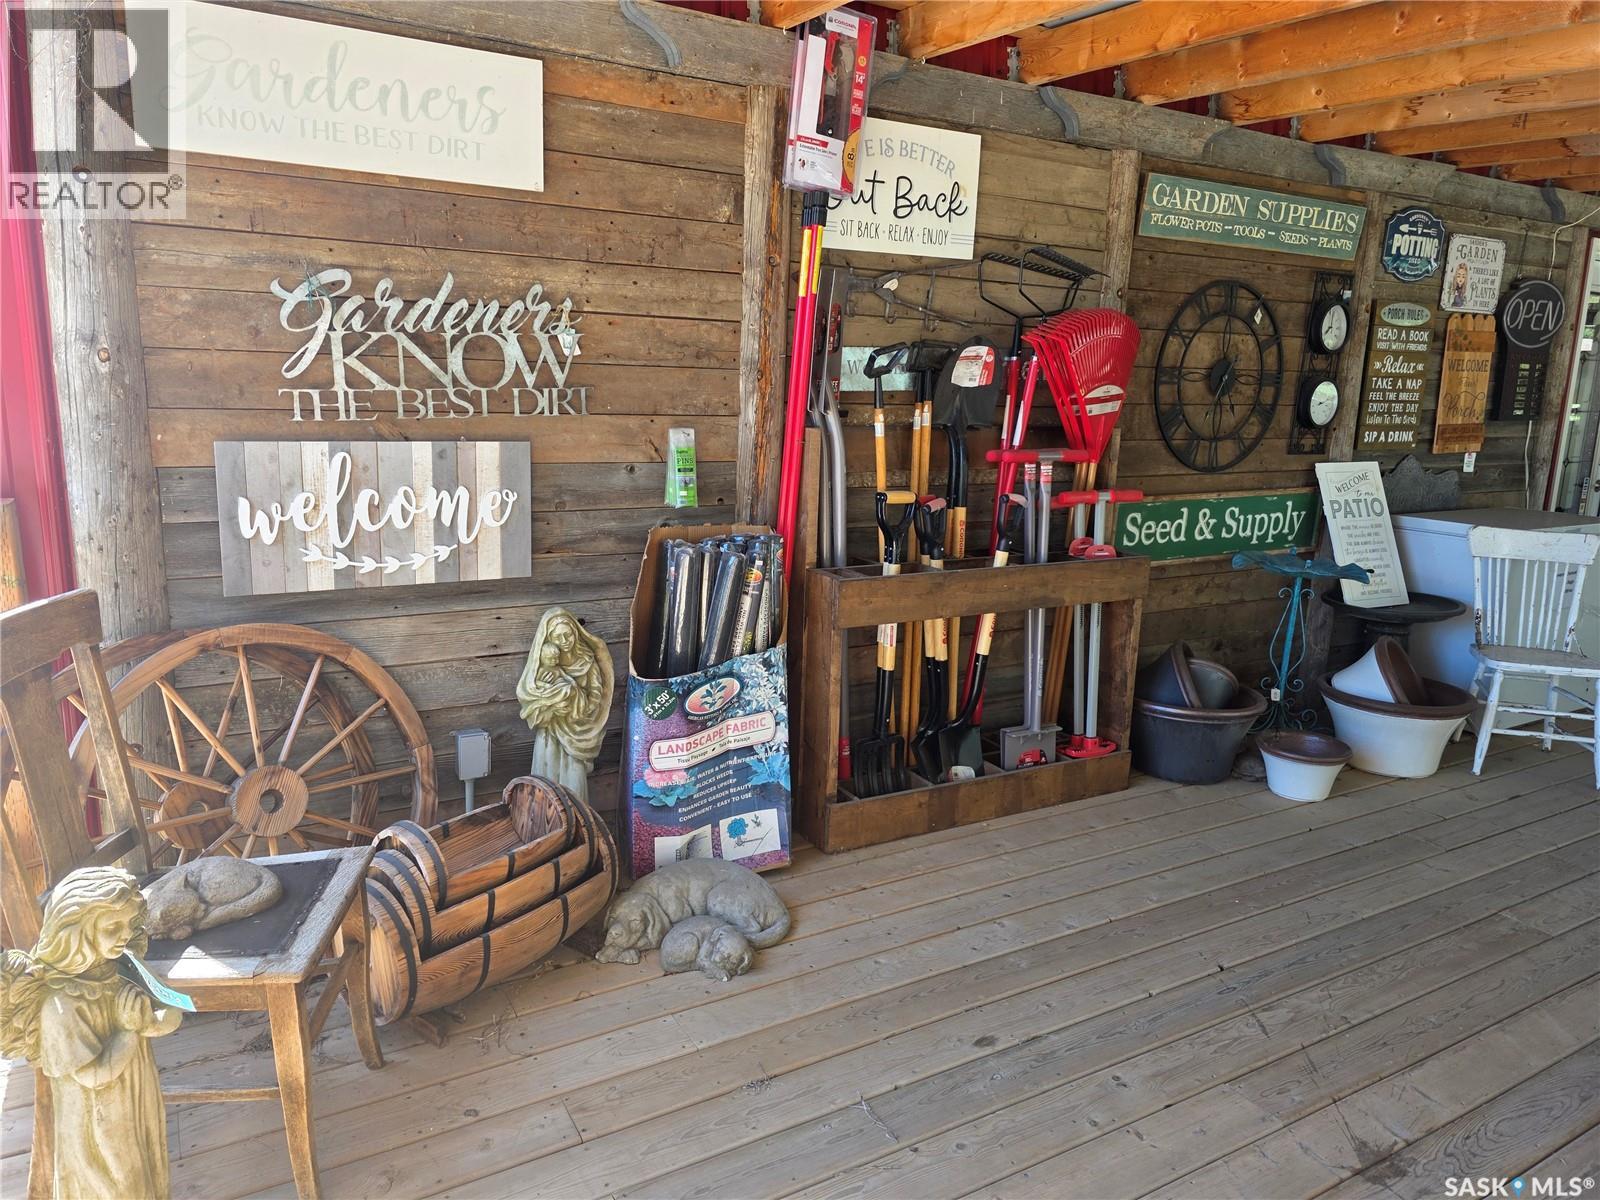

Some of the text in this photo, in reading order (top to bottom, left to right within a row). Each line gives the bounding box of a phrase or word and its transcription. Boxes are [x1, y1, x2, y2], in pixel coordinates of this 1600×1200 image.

[159, 27, 506, 135] Gardeners
[198, 105, 488, 162] KNOW THE BEST DIRT
[879, 137, 895, 158] IS
[900, 139, 956, 180] BETTER
[892, 175, 968, 223] Back
[1152, 183, 1360, 234] GARDEN SUPPLIES
[840, 218, 949, 246] SIT BACK RELAX ENJOY
[1233, 225, 1266, 240] TOOLS
[1279, 230, 1309, 245] SEEDS
[1318, 236, 1353, 252] PLANTS
[1391, 233, 1439, 259] POTTING
[1457, 243, 1499, 263] GARDEN
[269, 267, 583, 379] Gardeners
[1387, 307, 1406, 320] PORCH
[1507, 298, 1561, 331] OPEN
[1376, 341, 1428, 352] VISIT WITH FRIENDS
[1377, 327, 1430, 342] READ A BOOK
[325, 330, 585, 391] KNOW
[1381, 354, 1417, 374] Relax
[1447, 358, 1489, 373] WELCOME
[1368, 391, 1420, 401] FEEL THE BREEZE
[1372, 377, 1423, 390] TAKE A NAP
[278, 386, 594, 421] THE BEST DIRT
[1368, 402, 1419, 413] ENJOY THE DAY
[1364, 431, 1415, 443] SIP A DRINK
[677, 457, 694, 465] PINS
[1335, 471, 1370, 494] WELCOME
[237, 451, 518, 549] welcome
[1329, 497, 1385, 520] PATIO
[1123, 500, 1306, 547] Seed & Supply
[657, 717, 767, 756] LANDSCAPE FABRIC
[697, 769, 714, 780] WATER
[720, 758, 745, 769] NUTRIENT
[715, 769, 734, 780] WEEDS
[678, 783, 752, 813] ENHANCES GARDEN BEAUTY
[693, 786, 717, 799] REDUCES
[679, 792, 753, 823] CONVENIENT EASY TO USE
